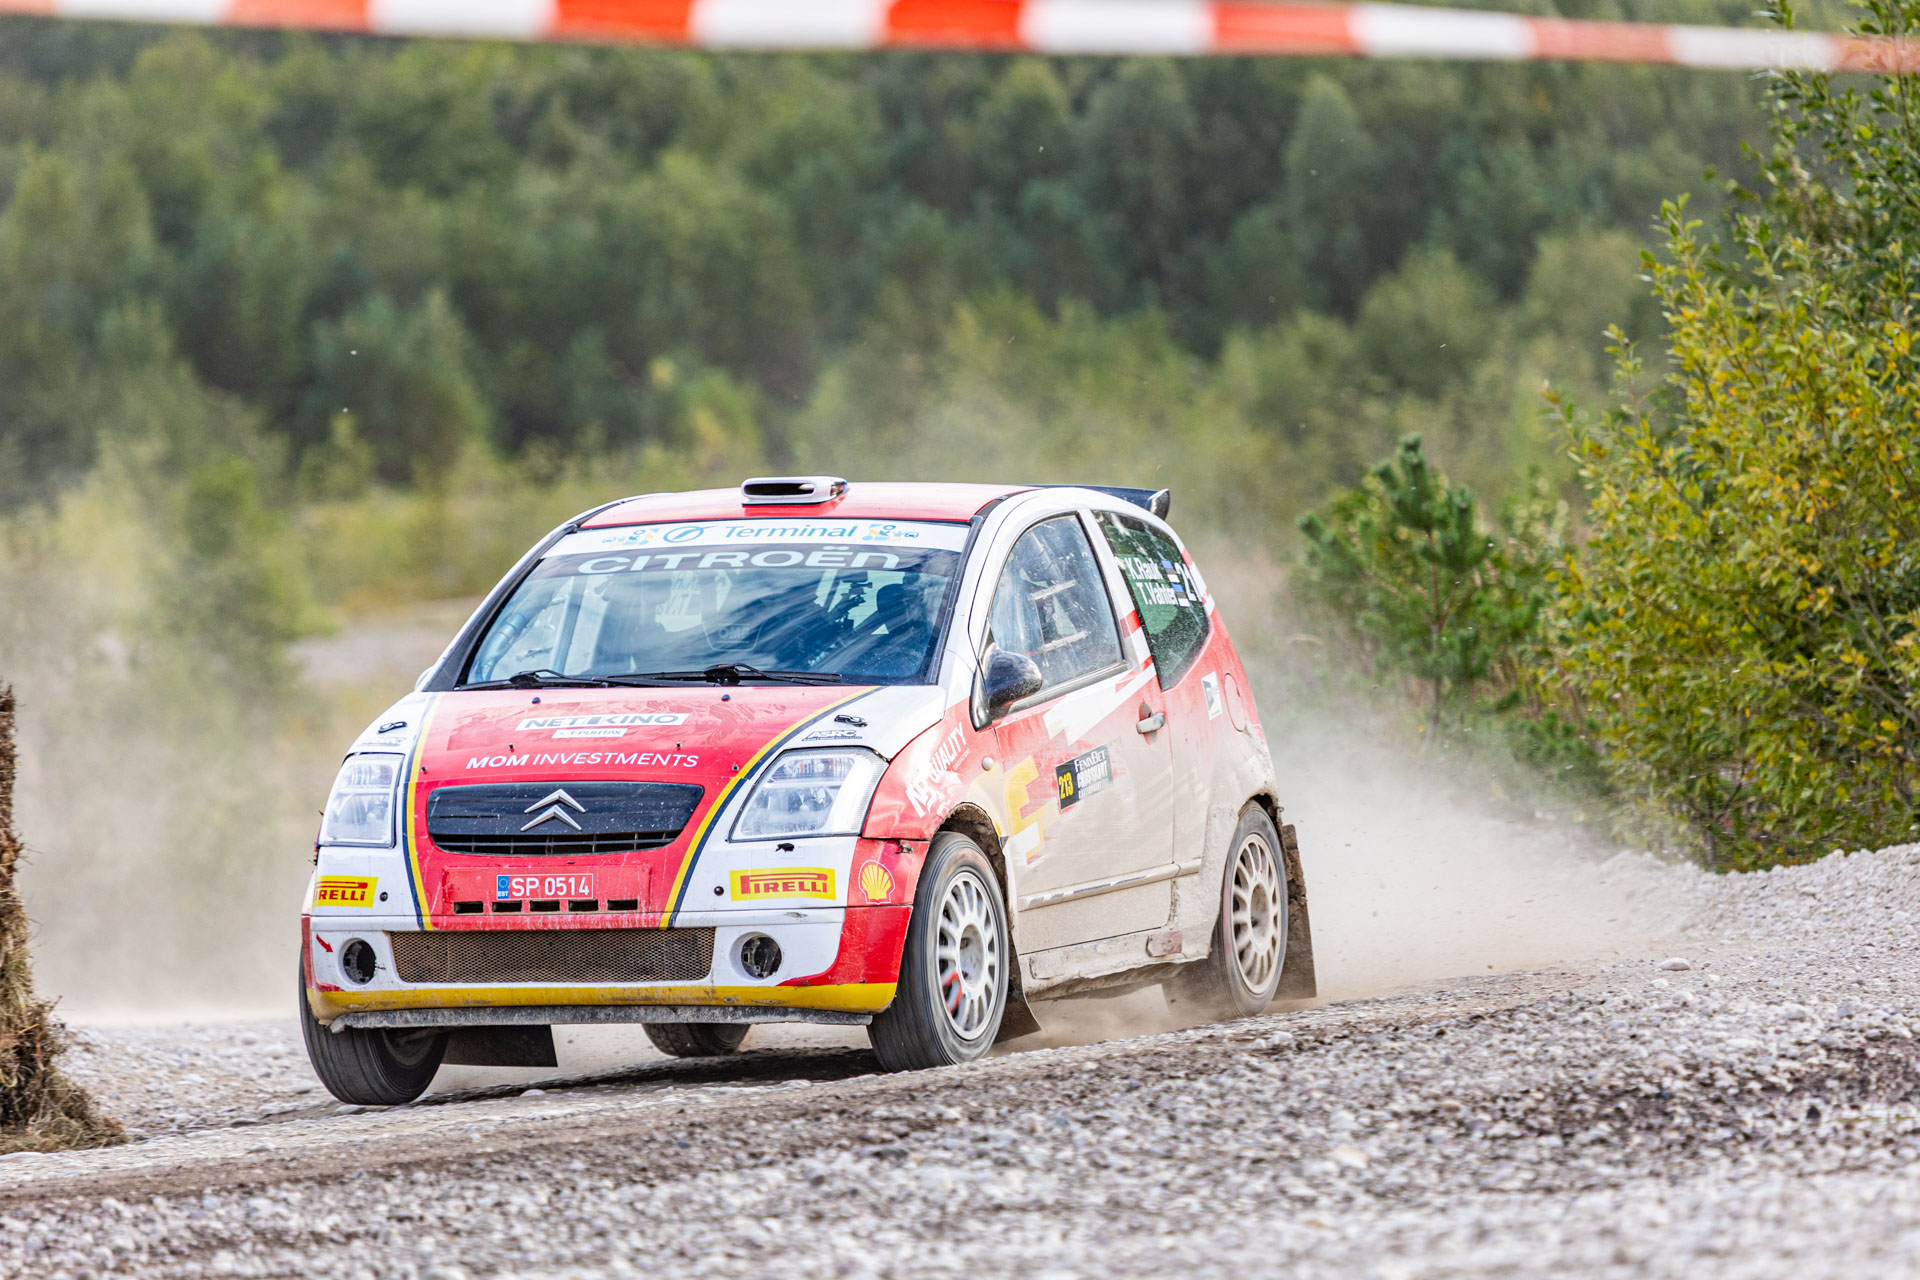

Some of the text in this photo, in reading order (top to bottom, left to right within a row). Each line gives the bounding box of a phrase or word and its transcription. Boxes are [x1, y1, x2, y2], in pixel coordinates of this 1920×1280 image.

[725, 524, 858, 539] Terminal
[465, 751, 700, 770] MOM INVESTMENTS
[1058, 771, 1074, 800] 213
[316, 880, 368, 902] RELLI
[497, 876, 590, 898] EST SP 0514
[739, 872, 828, 895] PIRELLI
